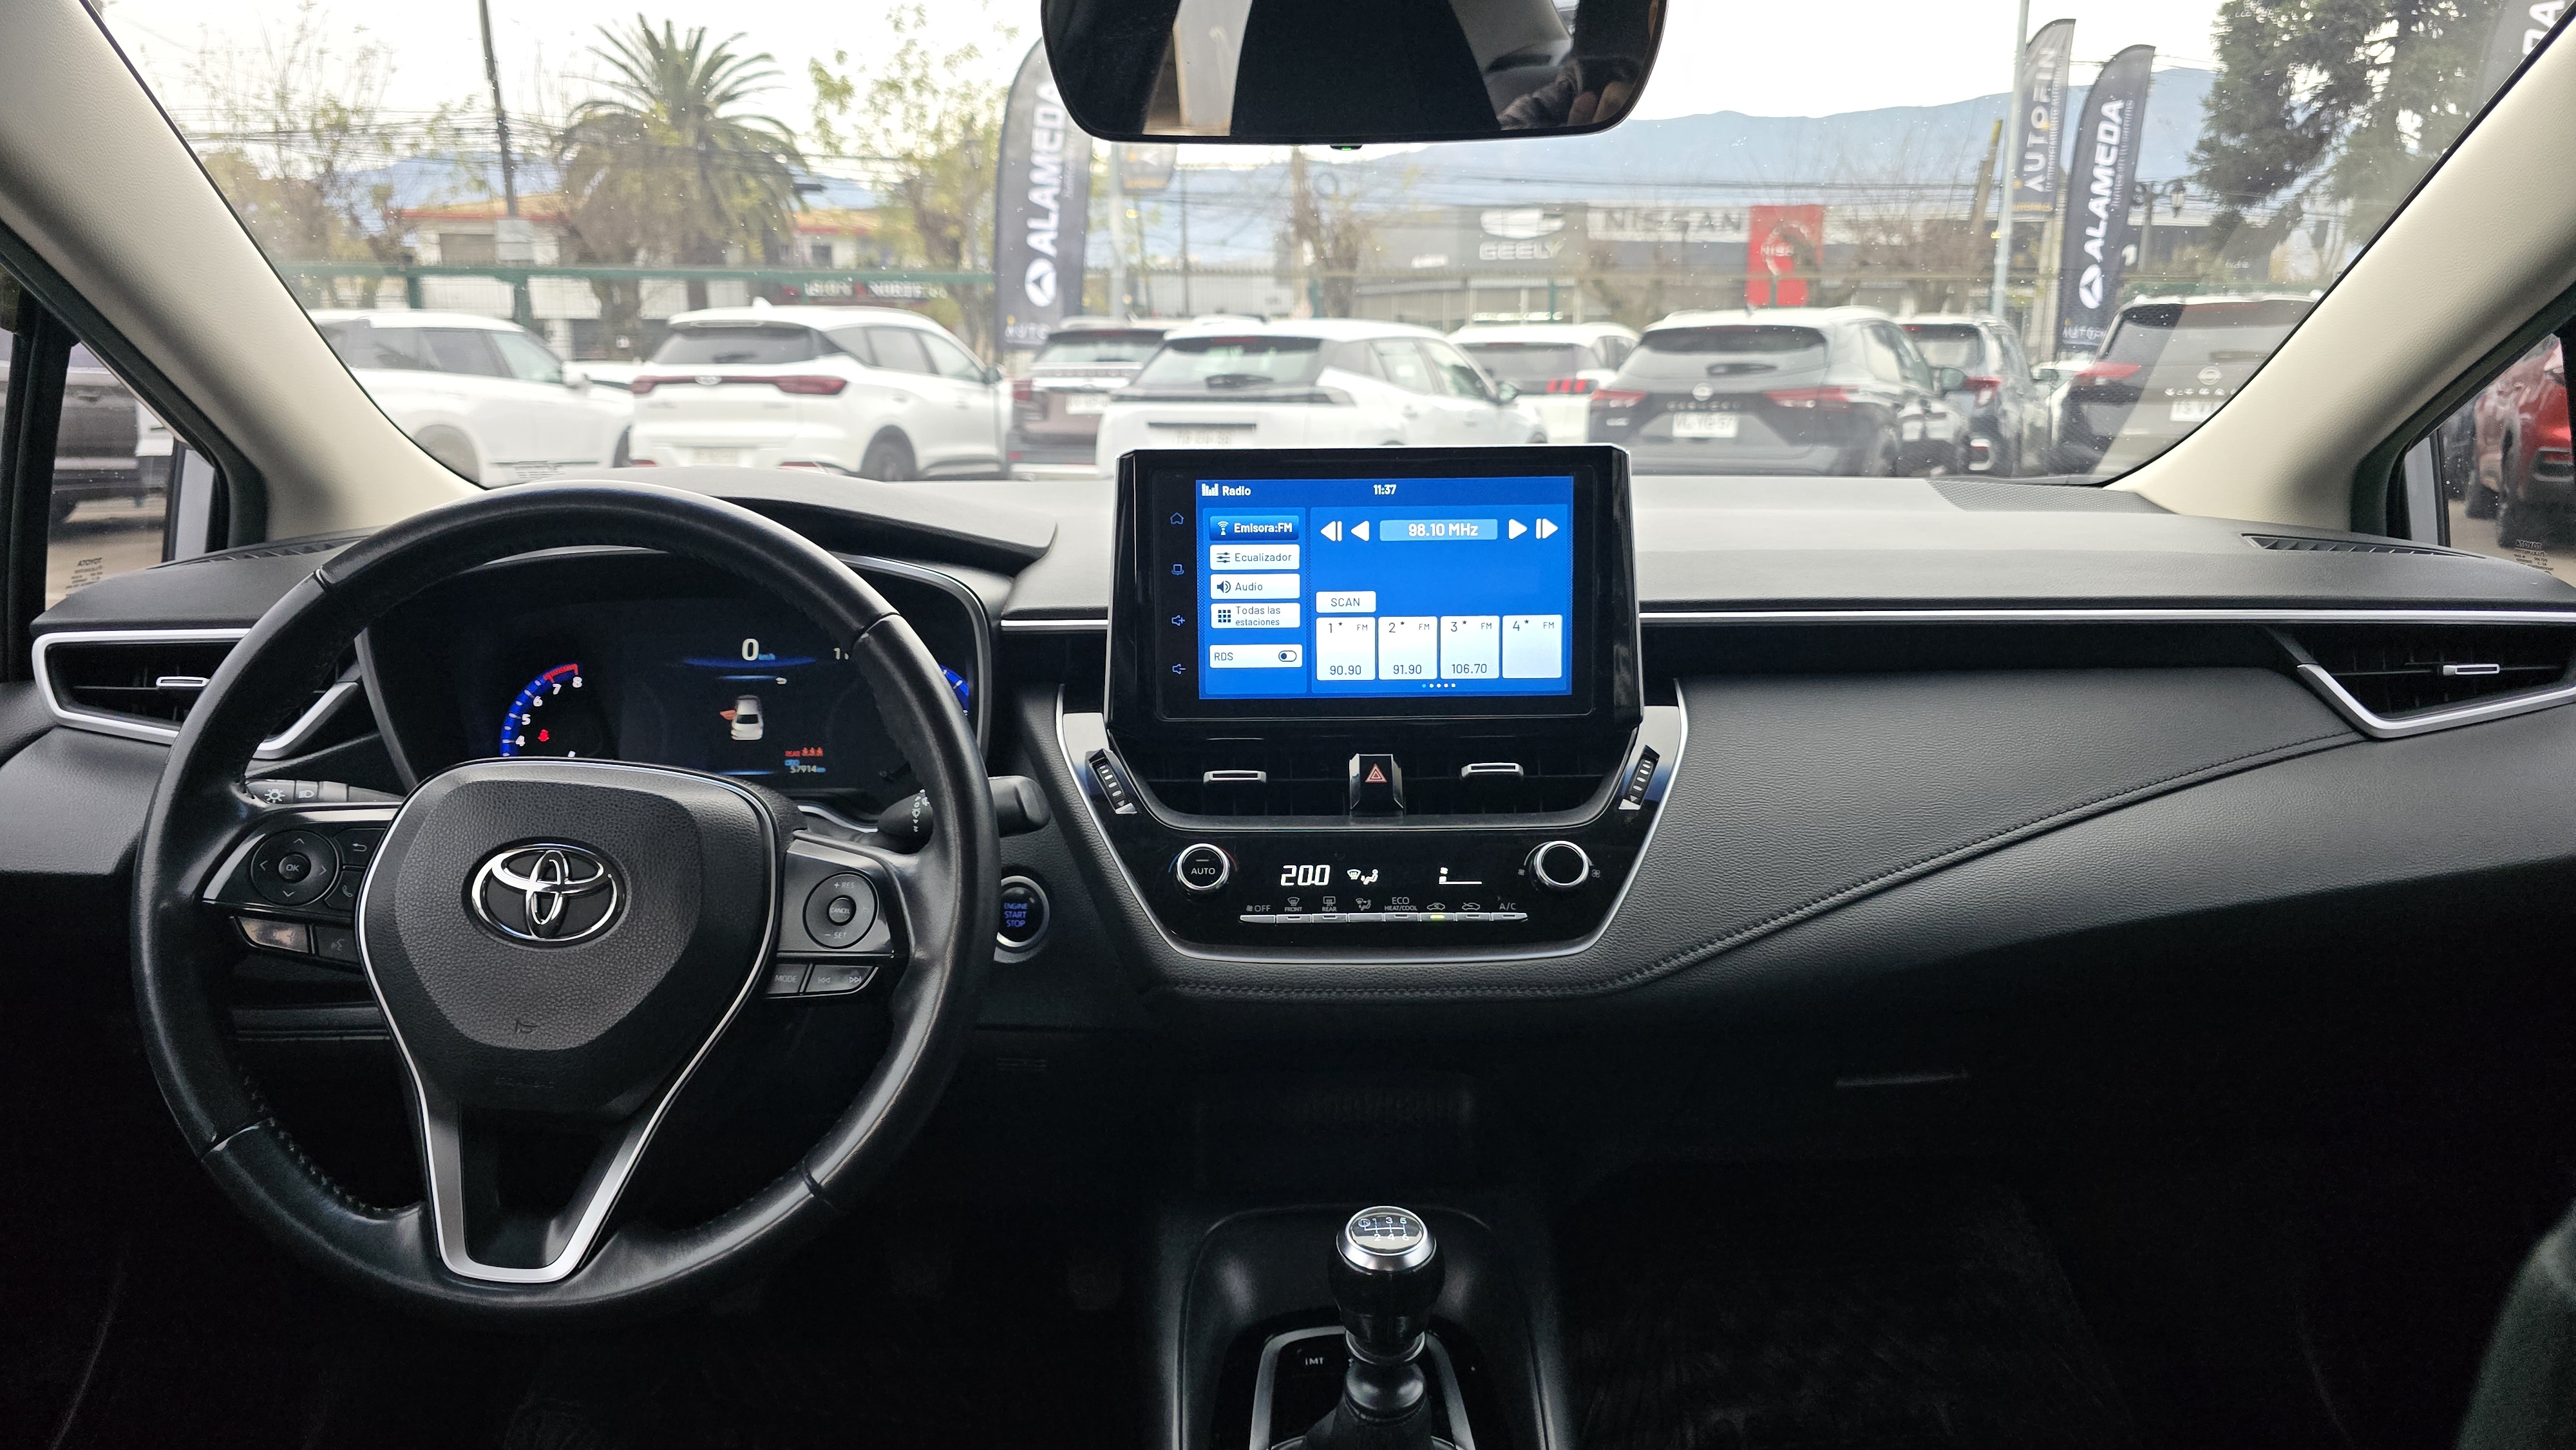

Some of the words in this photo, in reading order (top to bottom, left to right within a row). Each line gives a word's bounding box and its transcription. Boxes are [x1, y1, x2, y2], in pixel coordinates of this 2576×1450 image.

[2024, 48, 2056, 192] AUTOFIN
[1027, 80, 1066, 258] ALAMEDA
[2084, 99, 2125, 262] ALAMEDA
[1479, 240, 1566, 260] GEELY
[1222, 485, 1251, 496] Radio
[1373, 484, 1397, 495] 11:37
[1234, 522, 1293, 533] Emisora:FM
[1408, 523, 1445, 537] 98.10
[1448, 522, 1479, 536] MHz
[1235, 552, 1292, 562] Ecualizador
[1235, 582, 1263, 591] Audio
[1331, 598, 1360, 607] SCAN
[1236, 606, 1265, 615] Todas
[1267, 606, 1281, 615] las
[1235, 617, 1280, 626] estaciones
[1450, 621, 1457, 632] 3
[1512, 621, 1520, 632] 4
[1328, 623, 1332, 634] 1
[1388, 622, 1396, 633] 2
[742, 638, 759, 661] 0
[1214, 652, 1233, 661] RDS
[1330, 665, 1361, 675] 90.90
[1393, 664, 1422, 675] 91.90
[1451, 663, 1487, 673] 106.70
[573, 677, 582, 688] 8
[553, 684, 562, 695] 7
[533, 696, 542, 706] 6
[522, 714, 531, 725] 5
[515, 735, 526, 747] 4
[790, 765, 817, 773] 57914
